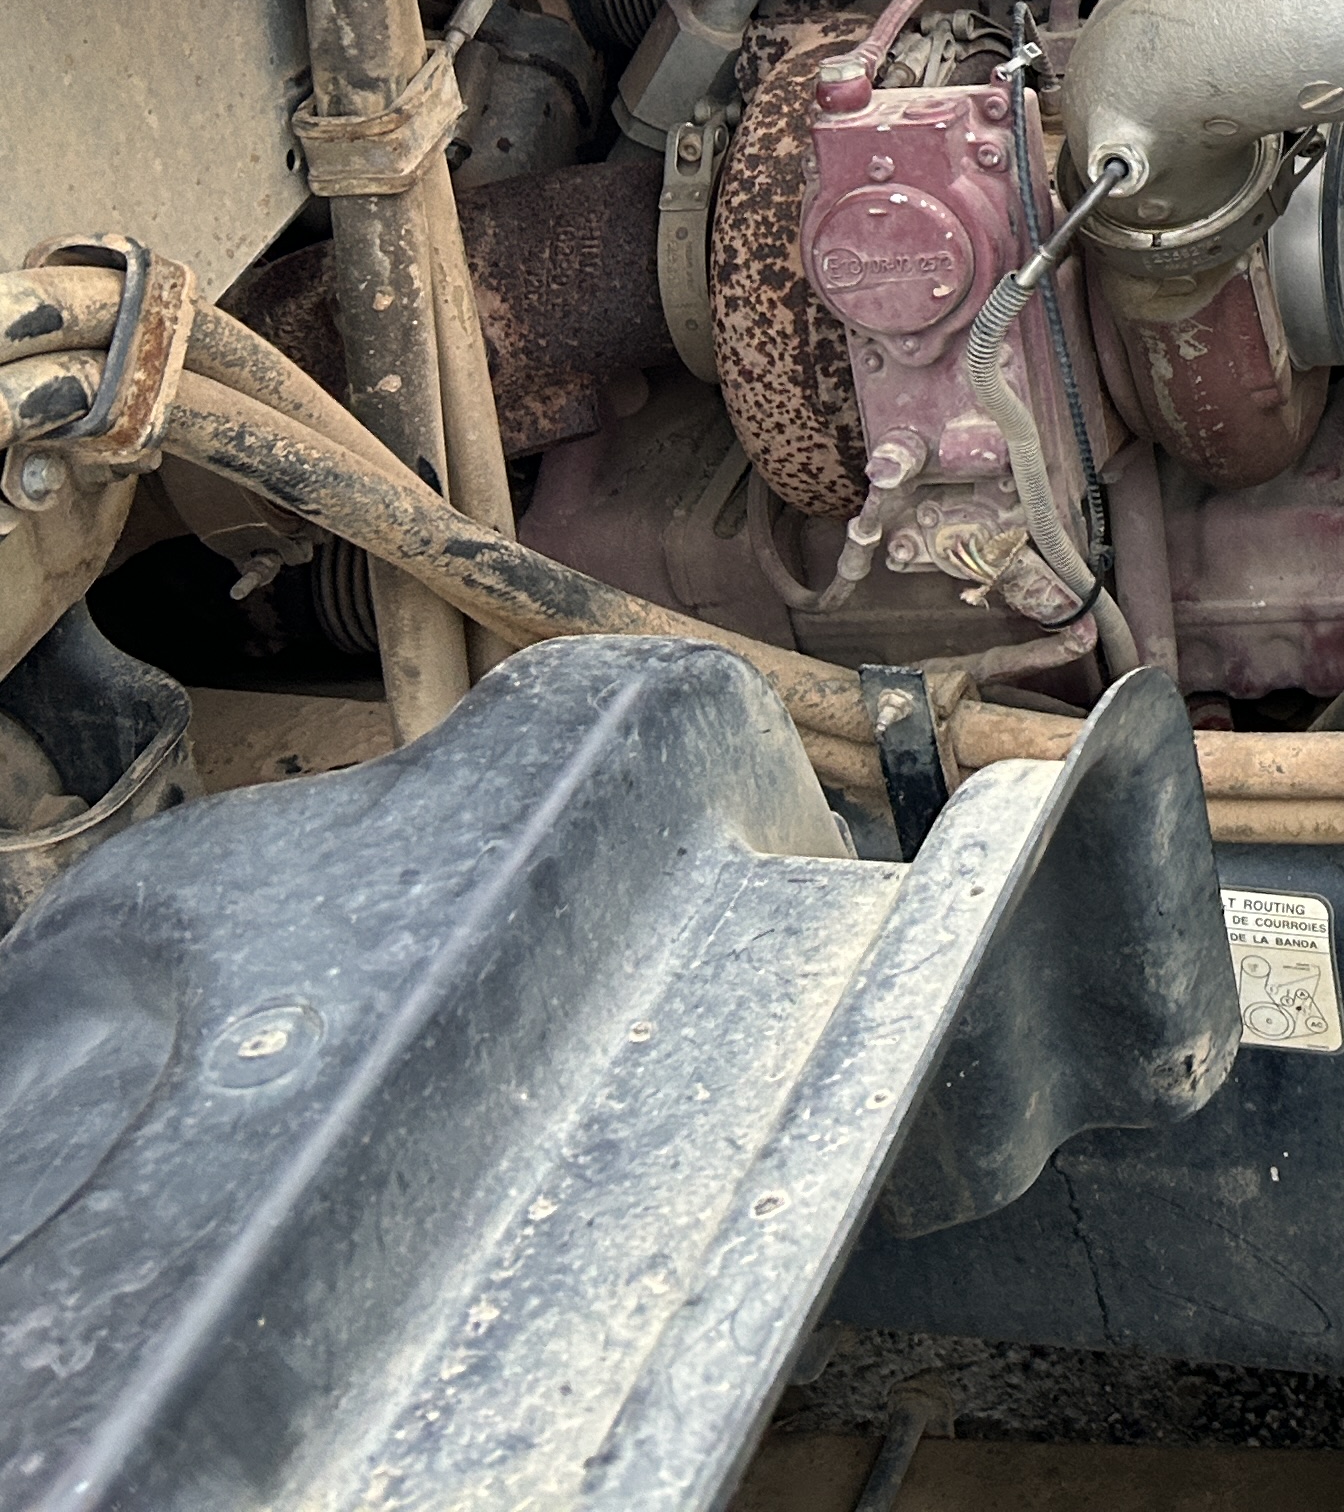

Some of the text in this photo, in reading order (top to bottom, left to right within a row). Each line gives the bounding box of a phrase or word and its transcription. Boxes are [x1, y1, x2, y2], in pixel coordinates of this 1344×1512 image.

[1244, 900, 1305, 915] ROUTING
[1232, 916, 1326, 933] DE COURROIES
[1230, 933, 1318, 949] DE LA BANDA
